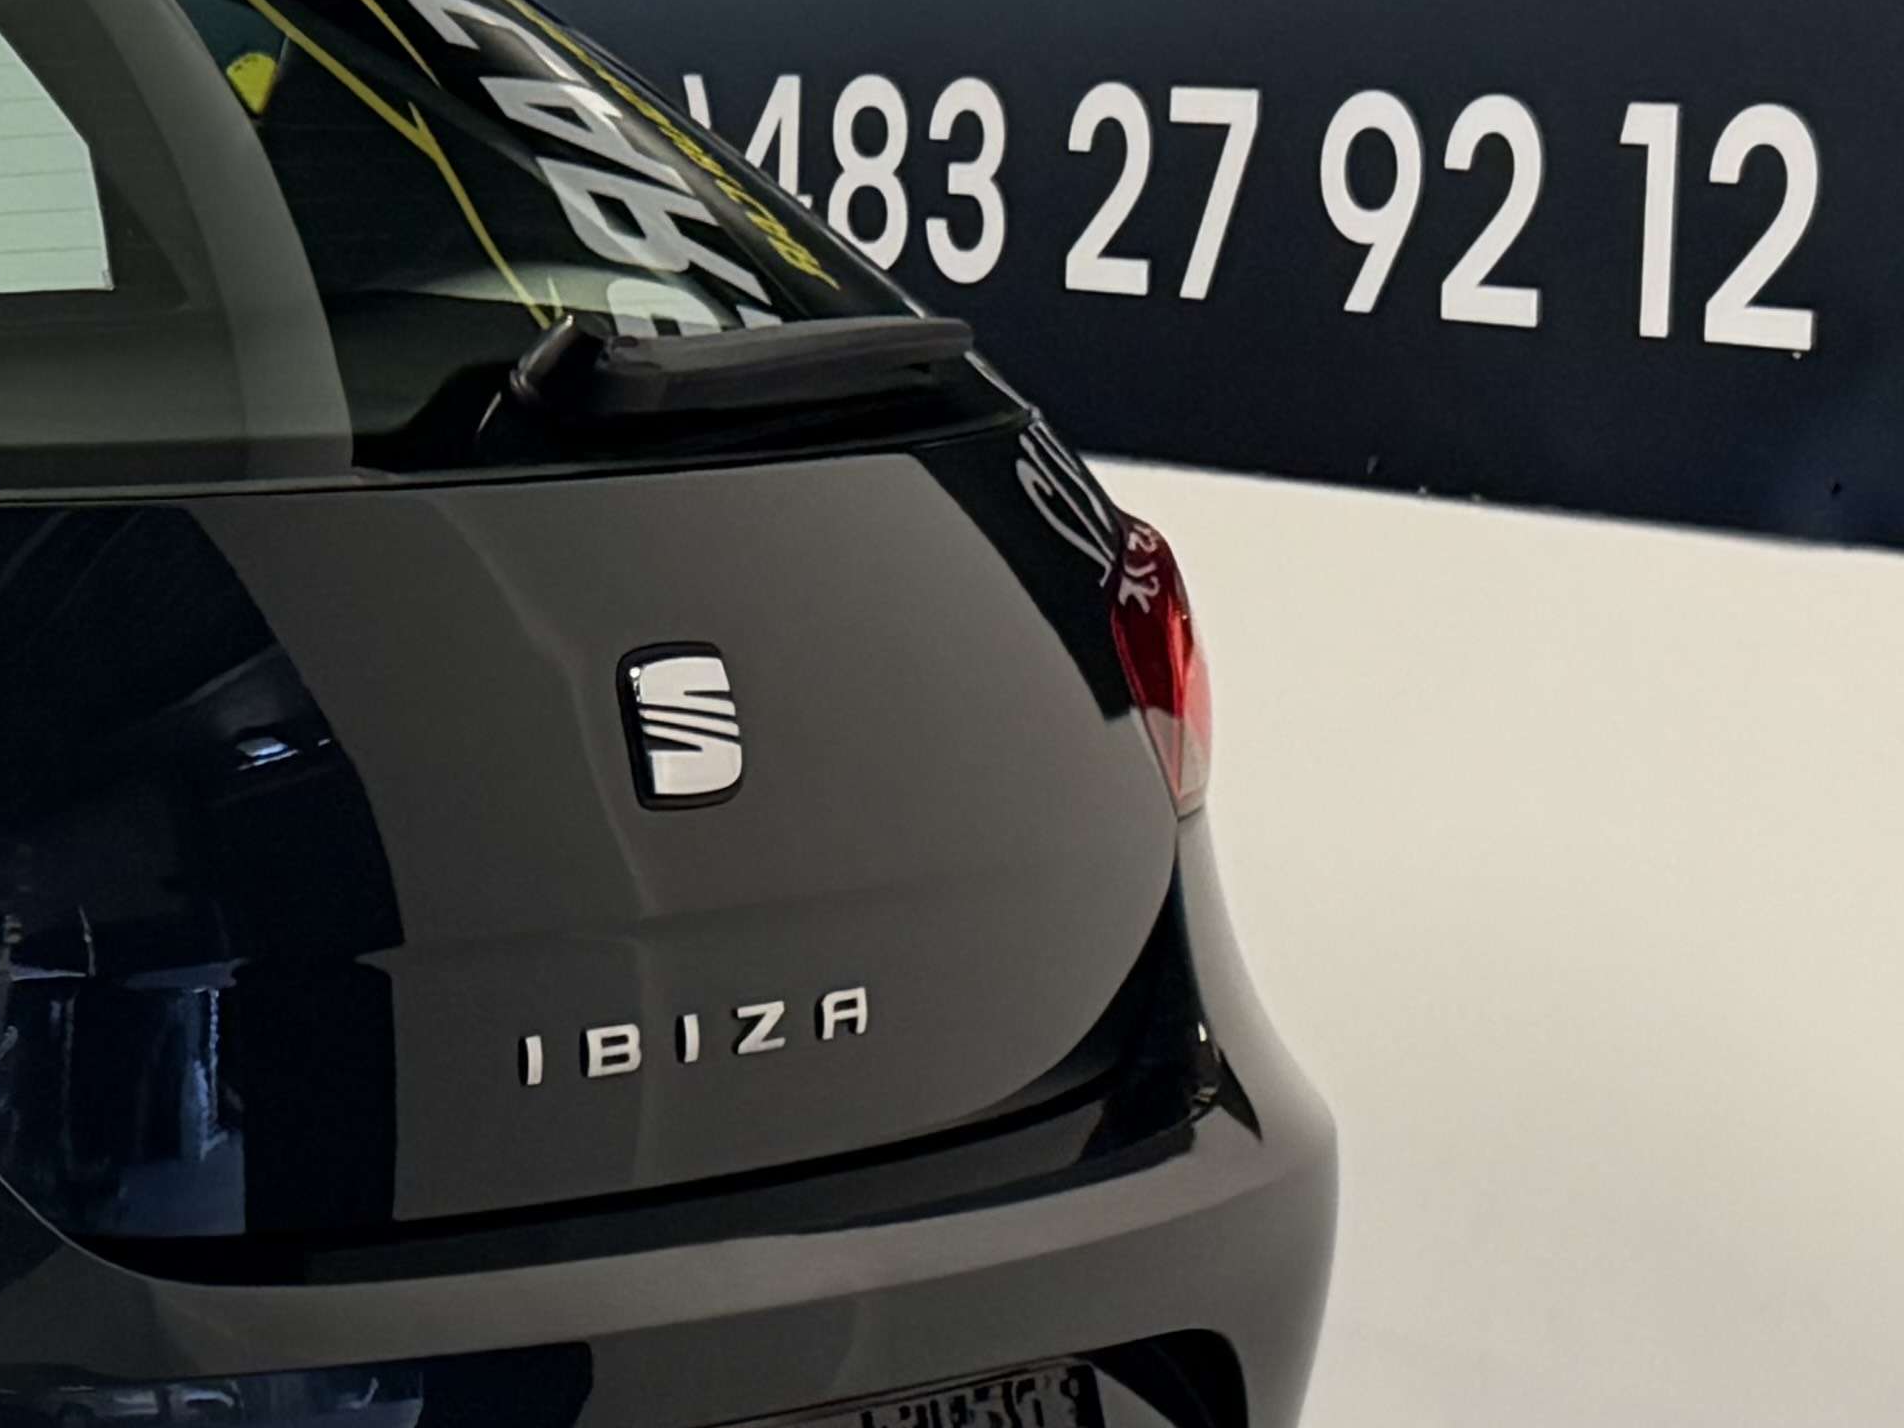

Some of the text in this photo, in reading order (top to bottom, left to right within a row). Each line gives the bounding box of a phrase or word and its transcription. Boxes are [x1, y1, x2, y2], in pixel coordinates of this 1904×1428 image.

[683, 72, 1007, 285] 483
[1064, 82, 1260, 300] 27
[1320, 89, 1542, 328] 92
[1620, 102, 1818, 351] 12
[522, 987, 868, 1086] IBIZA
